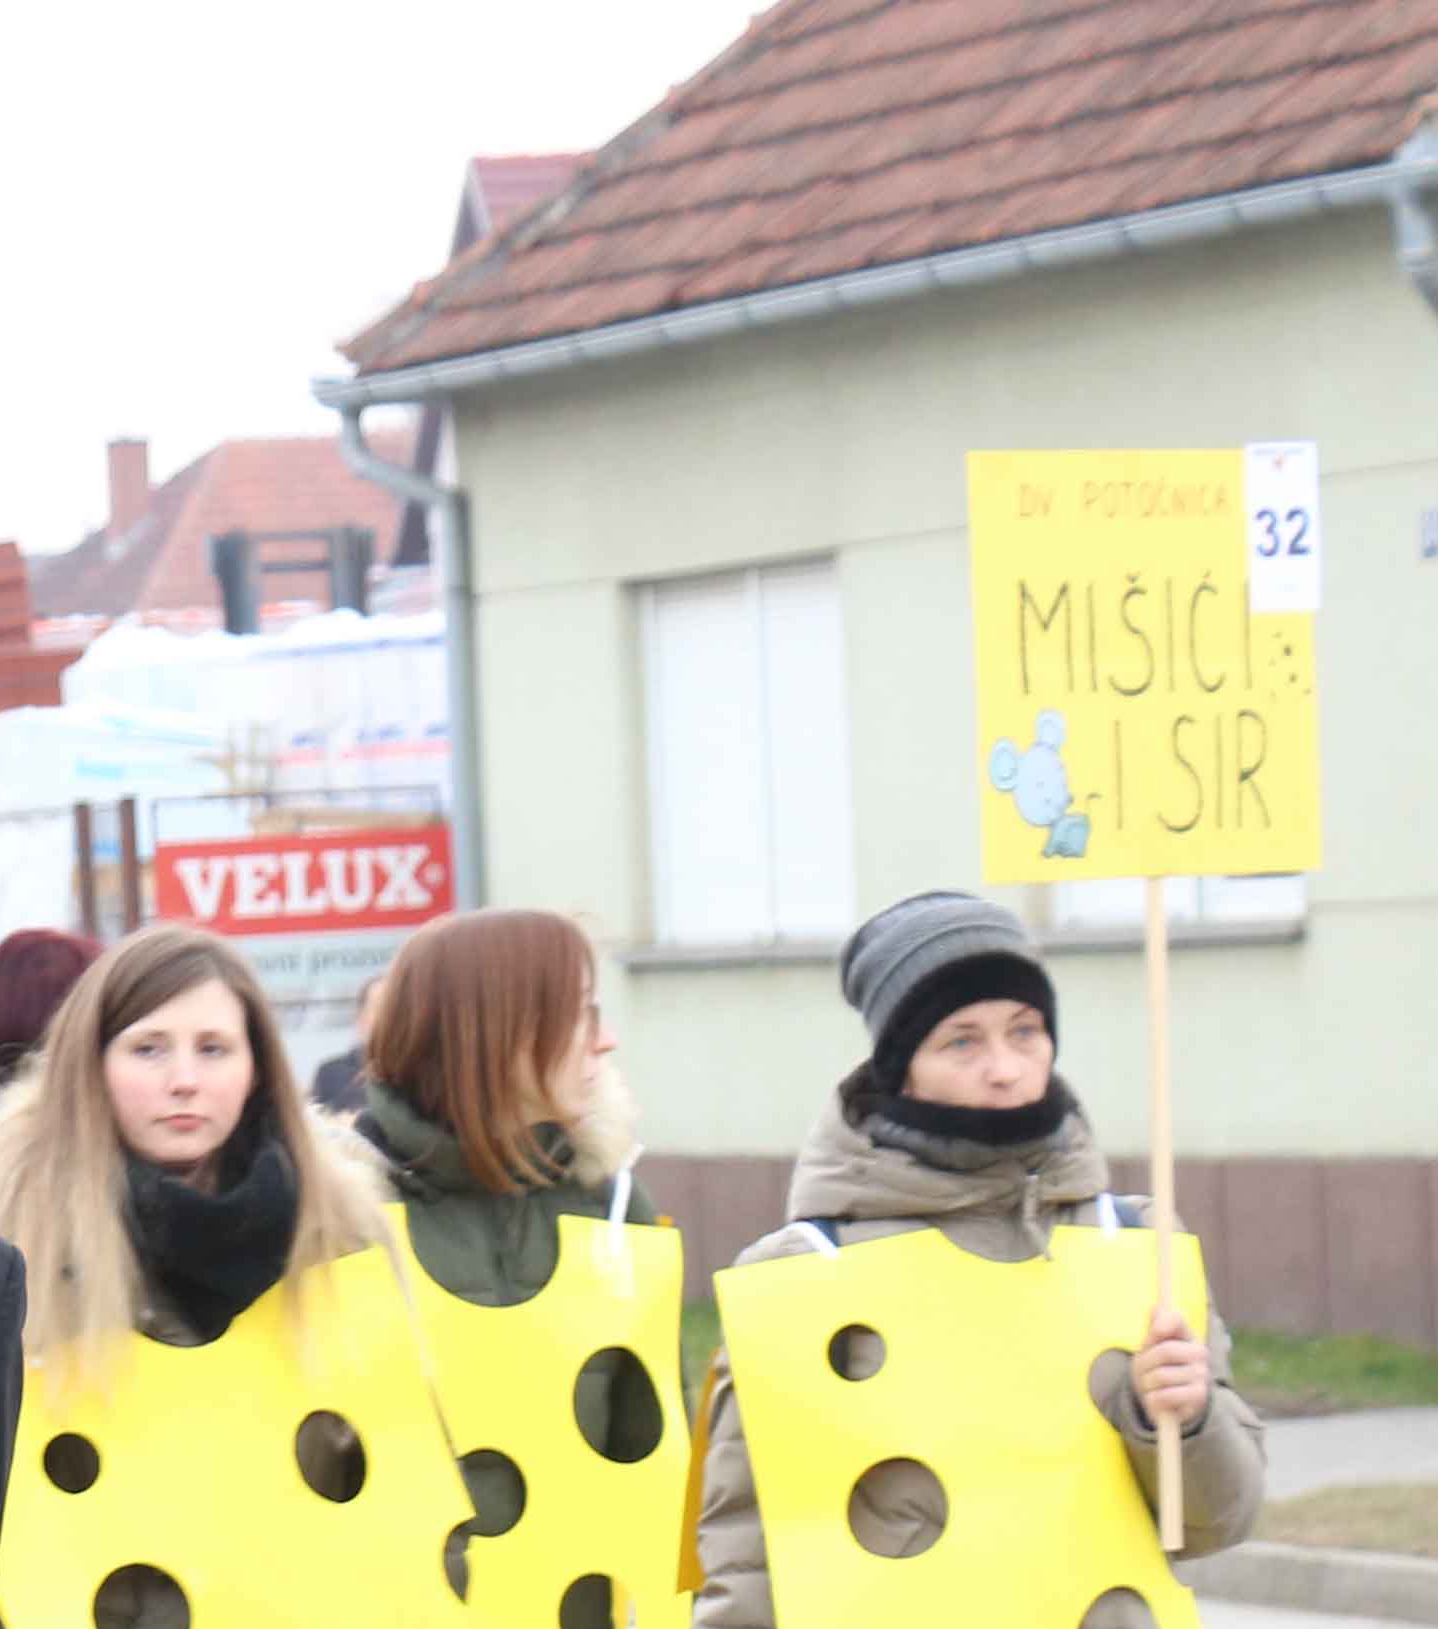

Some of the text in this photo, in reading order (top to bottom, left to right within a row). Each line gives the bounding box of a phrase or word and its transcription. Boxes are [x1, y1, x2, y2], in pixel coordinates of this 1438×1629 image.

[1255, 507, 1312, 558] 32
[1113, 708, 1272, 834] I SIR
[174, 844, 433, 921] VELUX
